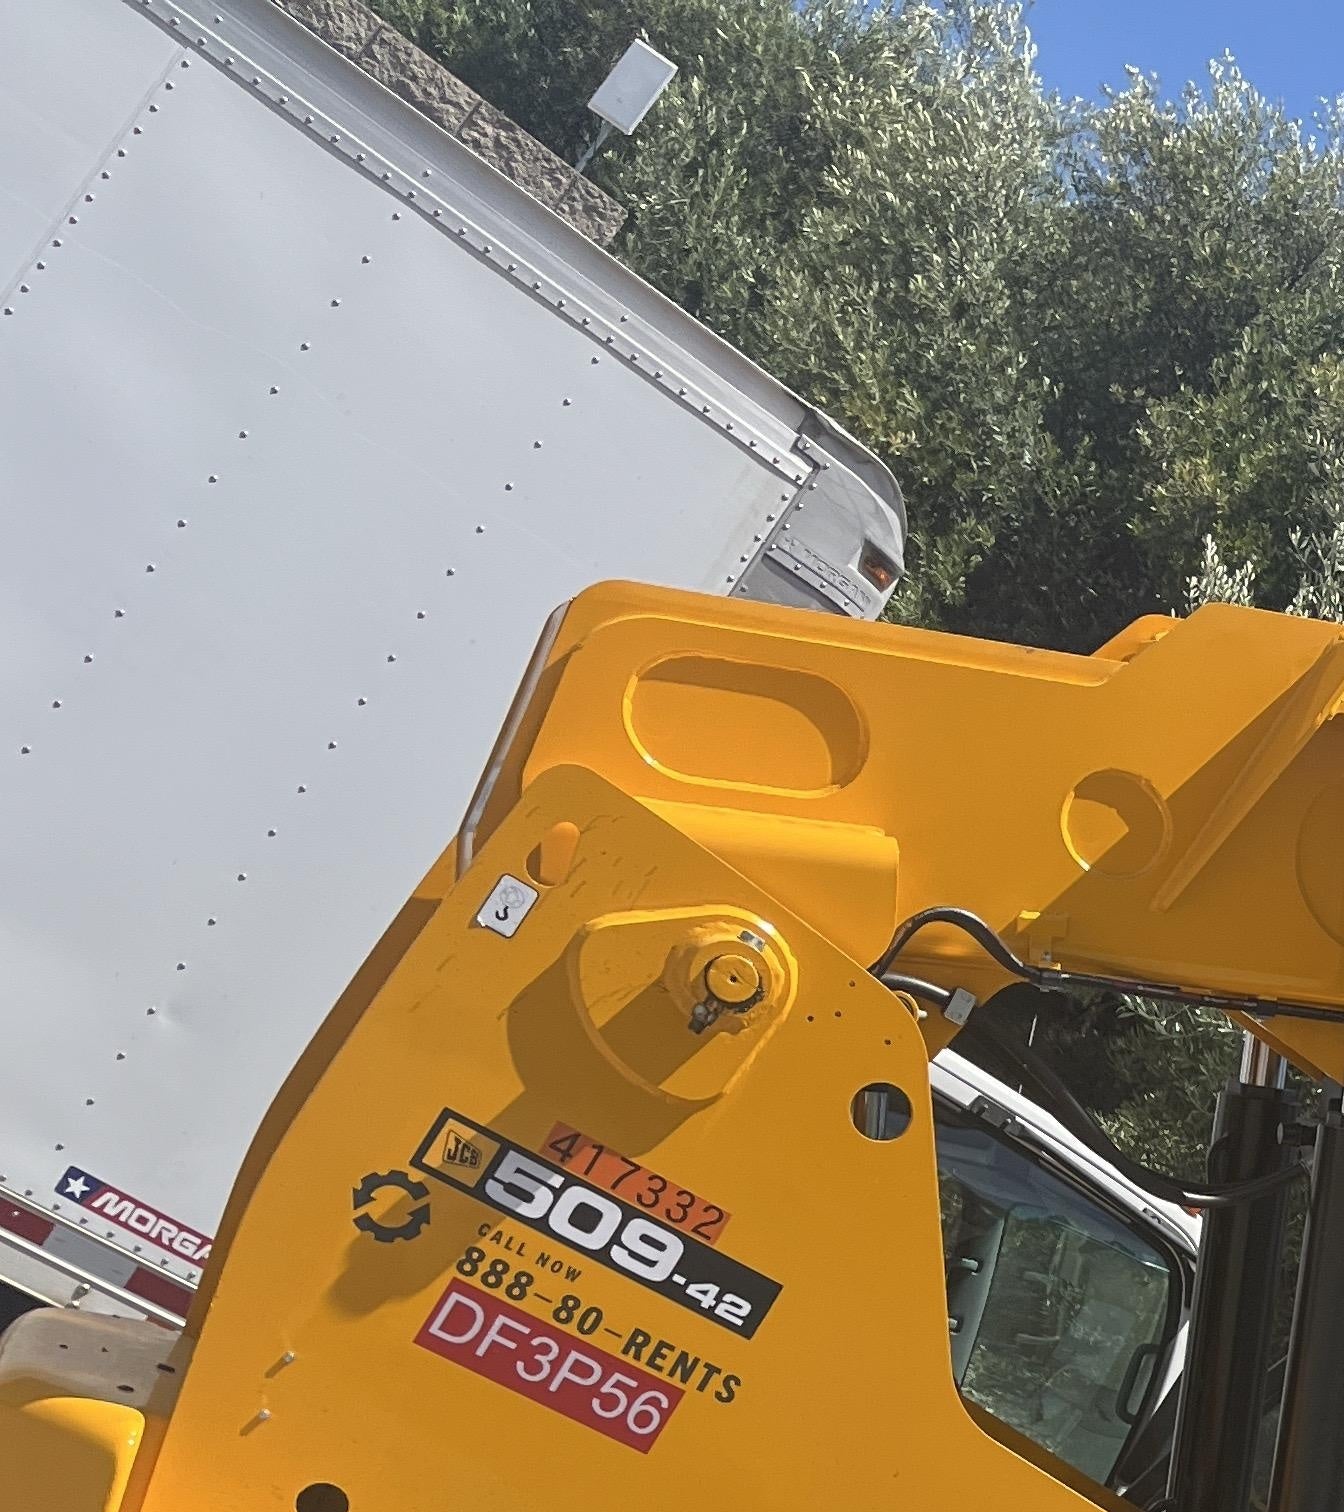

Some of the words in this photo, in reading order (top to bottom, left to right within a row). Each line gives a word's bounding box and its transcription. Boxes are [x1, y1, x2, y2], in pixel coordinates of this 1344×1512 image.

[446, 1135, 479, 1166] JCB
[548, 1132, 724, 1240] 417332
[91, 1192, 212, 1260] MORGA
[478, 1222, 526, 1258] CALL
[536, 1251, 582, 1283] NOW
[427, 1291, 669, 1436] DF3P56
